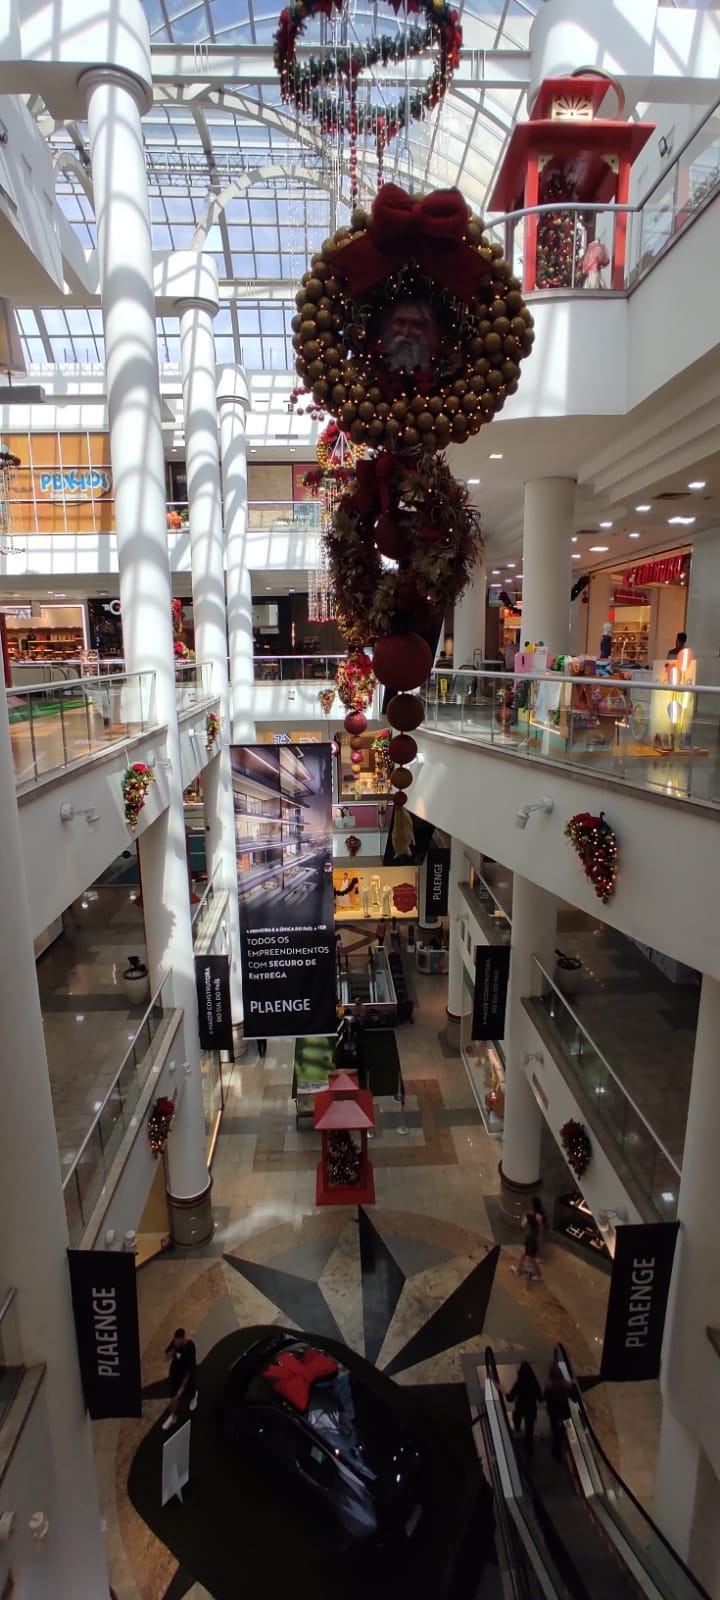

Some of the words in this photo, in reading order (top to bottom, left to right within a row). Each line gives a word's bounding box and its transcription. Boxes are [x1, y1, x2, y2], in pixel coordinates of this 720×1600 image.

[433, 863, 443, 900] PLAENGE
[247, 936, 276, 946] TODOS
[277, 936, 290, 944] OS
[248, 946, 329, 957] EMPREENDIMENTOS
[248, 961, 267, 969] COM
[268, 959, 304, 968] SEGURO
[305, 958, 317, 966] DE
[248, 971, 287, 980] ENTREGA
[215, 991, 222, 1001] DO
[250, 998, 311, 1014] PLAENGE
[216, 1013, 223, 1023] DO
[625, 1257, 655, 1347] PLAENGE
[92, 1287, 120, 1377] PLAENGE
